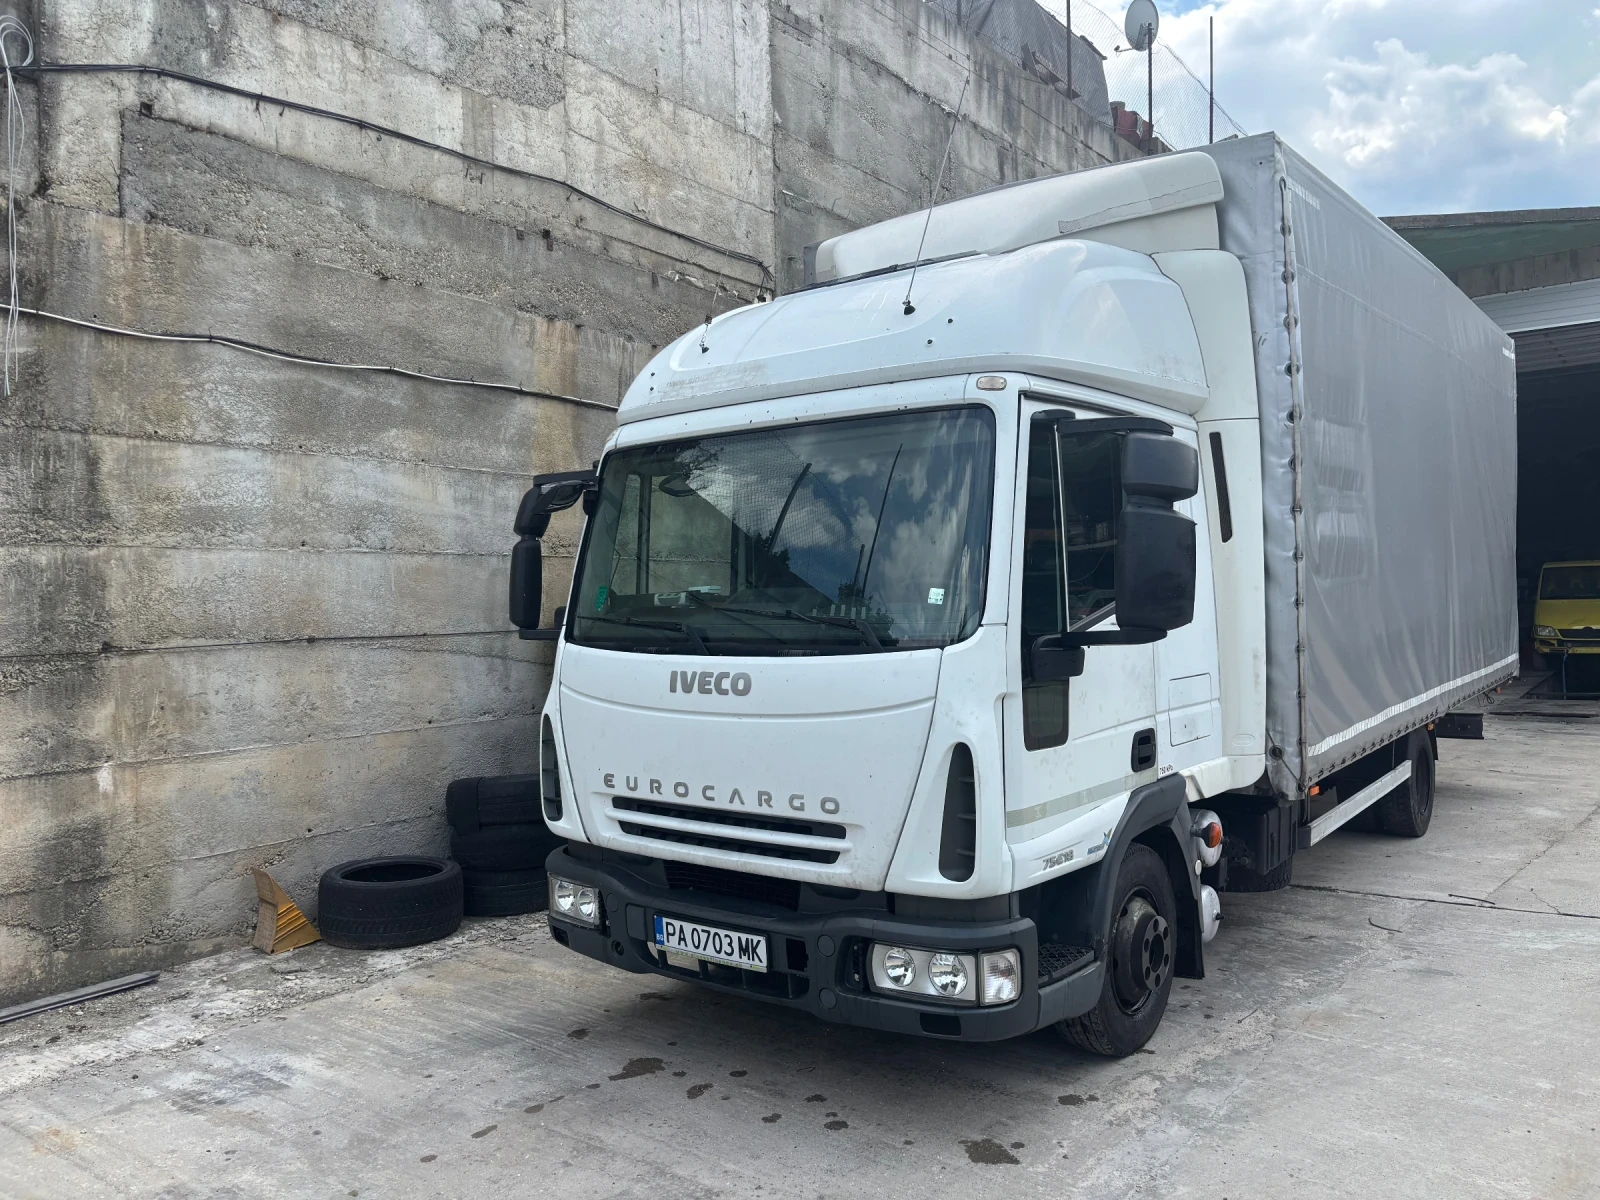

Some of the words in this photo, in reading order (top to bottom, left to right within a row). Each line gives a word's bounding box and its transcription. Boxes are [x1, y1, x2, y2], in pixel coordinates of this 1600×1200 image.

[669, 670, 752, 697] IVECO
[603, 773, 840, 815] EUROCARGO
[665, 921, 688, 948] PA
[691, 927, 735, 957] 0703
[737, 935, 763, 964] MK
